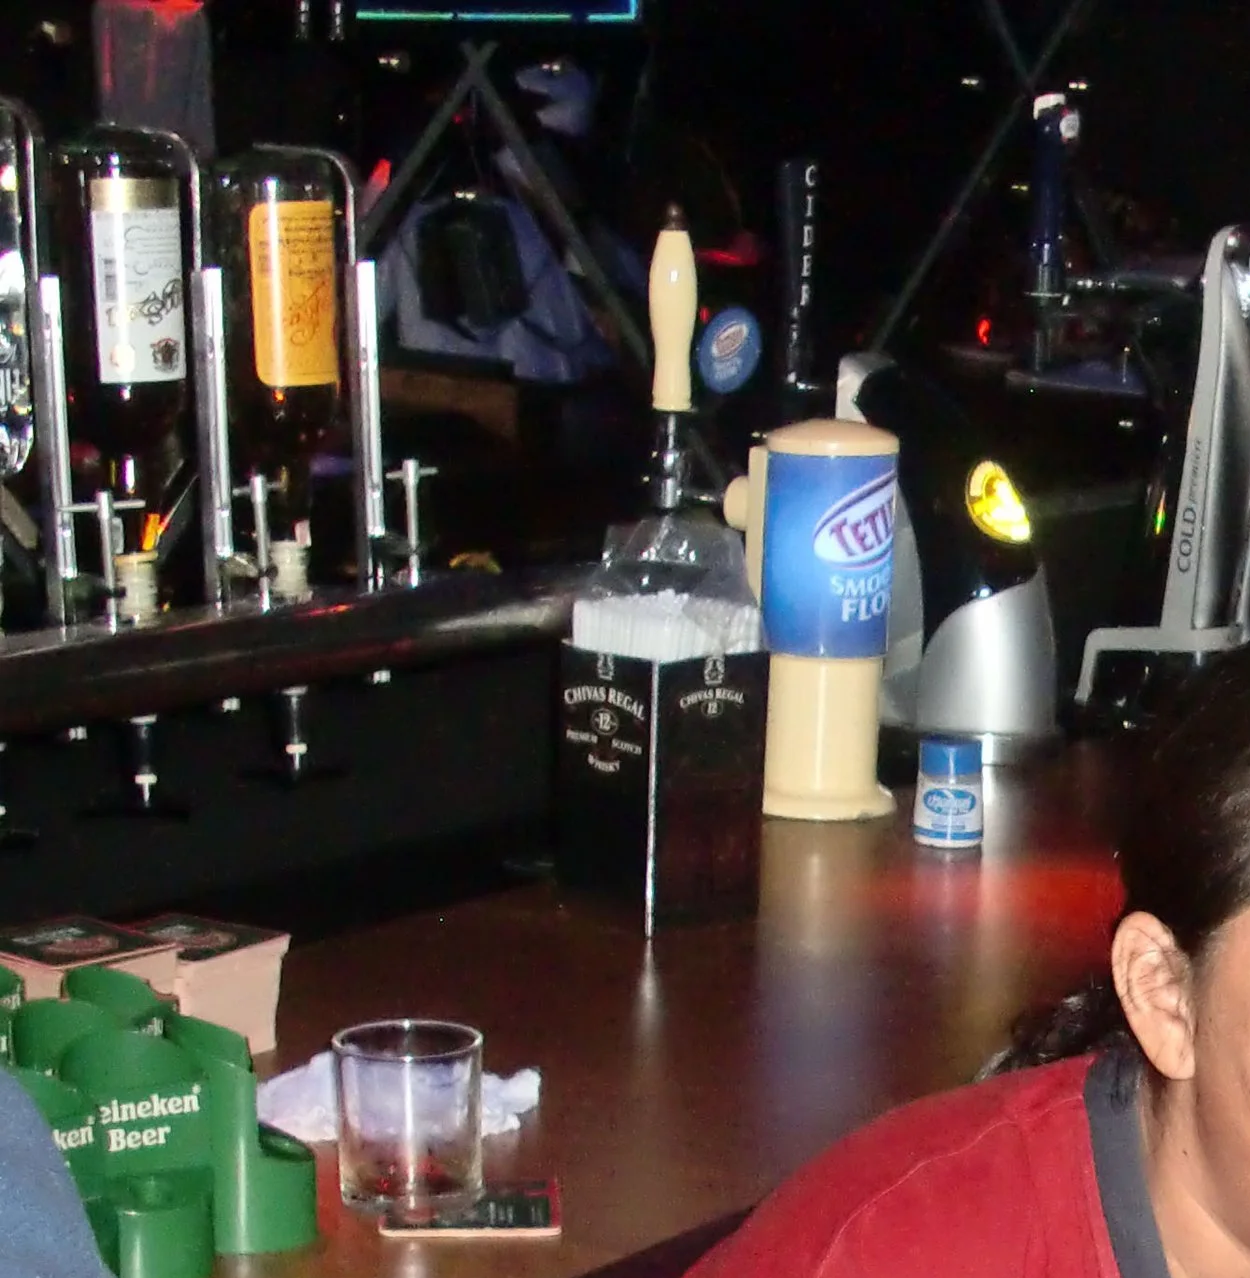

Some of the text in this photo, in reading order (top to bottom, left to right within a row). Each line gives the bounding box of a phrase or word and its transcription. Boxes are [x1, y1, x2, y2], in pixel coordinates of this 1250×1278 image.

[800, 165, 817, 306] CIDER
[1176, 507, 1197, 573] COLD
[841, 591, 892, 622] FLO
[563, 685, 646, 722] CHIVAS REGAL
[679, 687, 745, 709] CHIVAS REGAL
[706, 702, 718, 715] 12
[598, 712, 612, 732] 12
[587, 753, 621, 773] WHISKY
[108, 1126, 171, 1152] Beer
